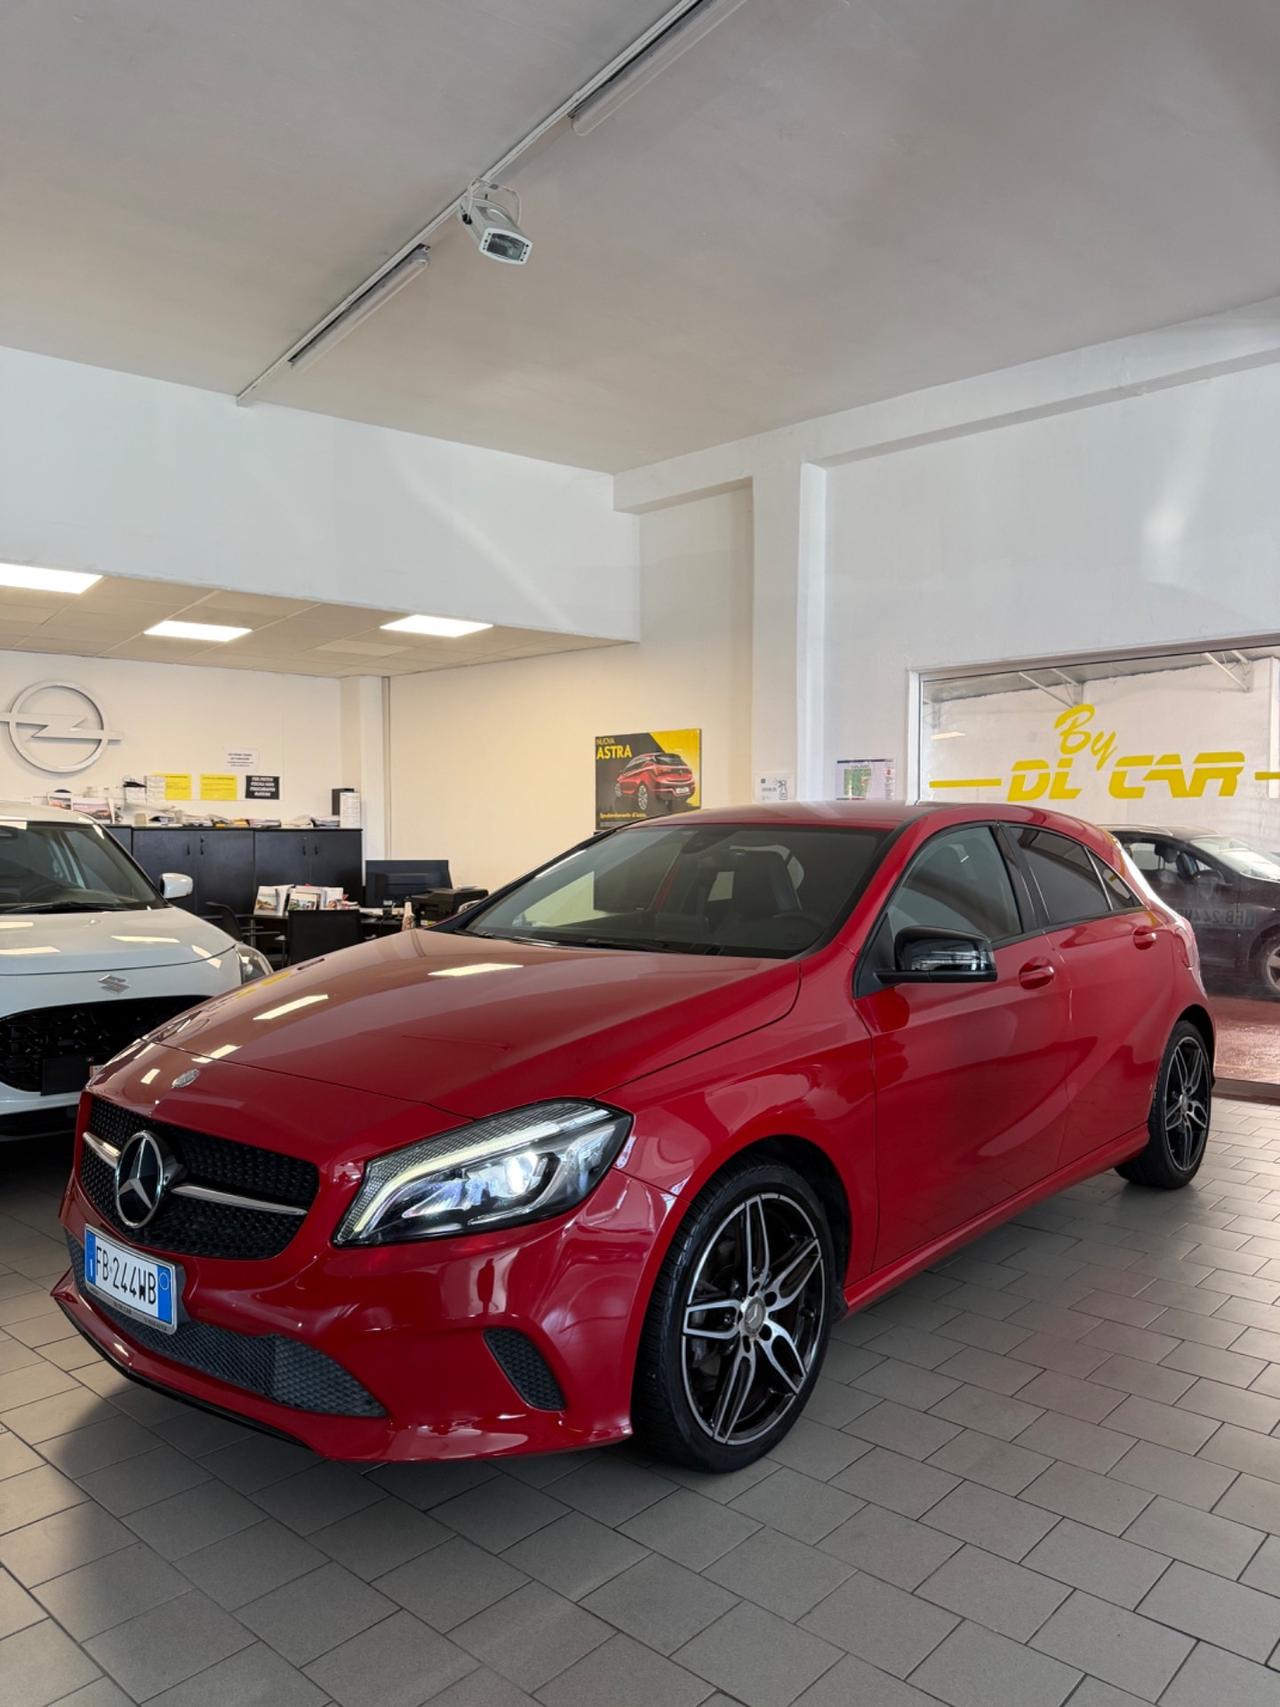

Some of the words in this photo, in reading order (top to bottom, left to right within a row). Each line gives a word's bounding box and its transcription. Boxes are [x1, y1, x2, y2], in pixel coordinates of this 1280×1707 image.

[596, 744, 633, 760] ASTRA
[1054, 703, 1118, 770] By
[1007, 758, 1082, 802] DL
[1108, 752, 1245, 799] CAR
